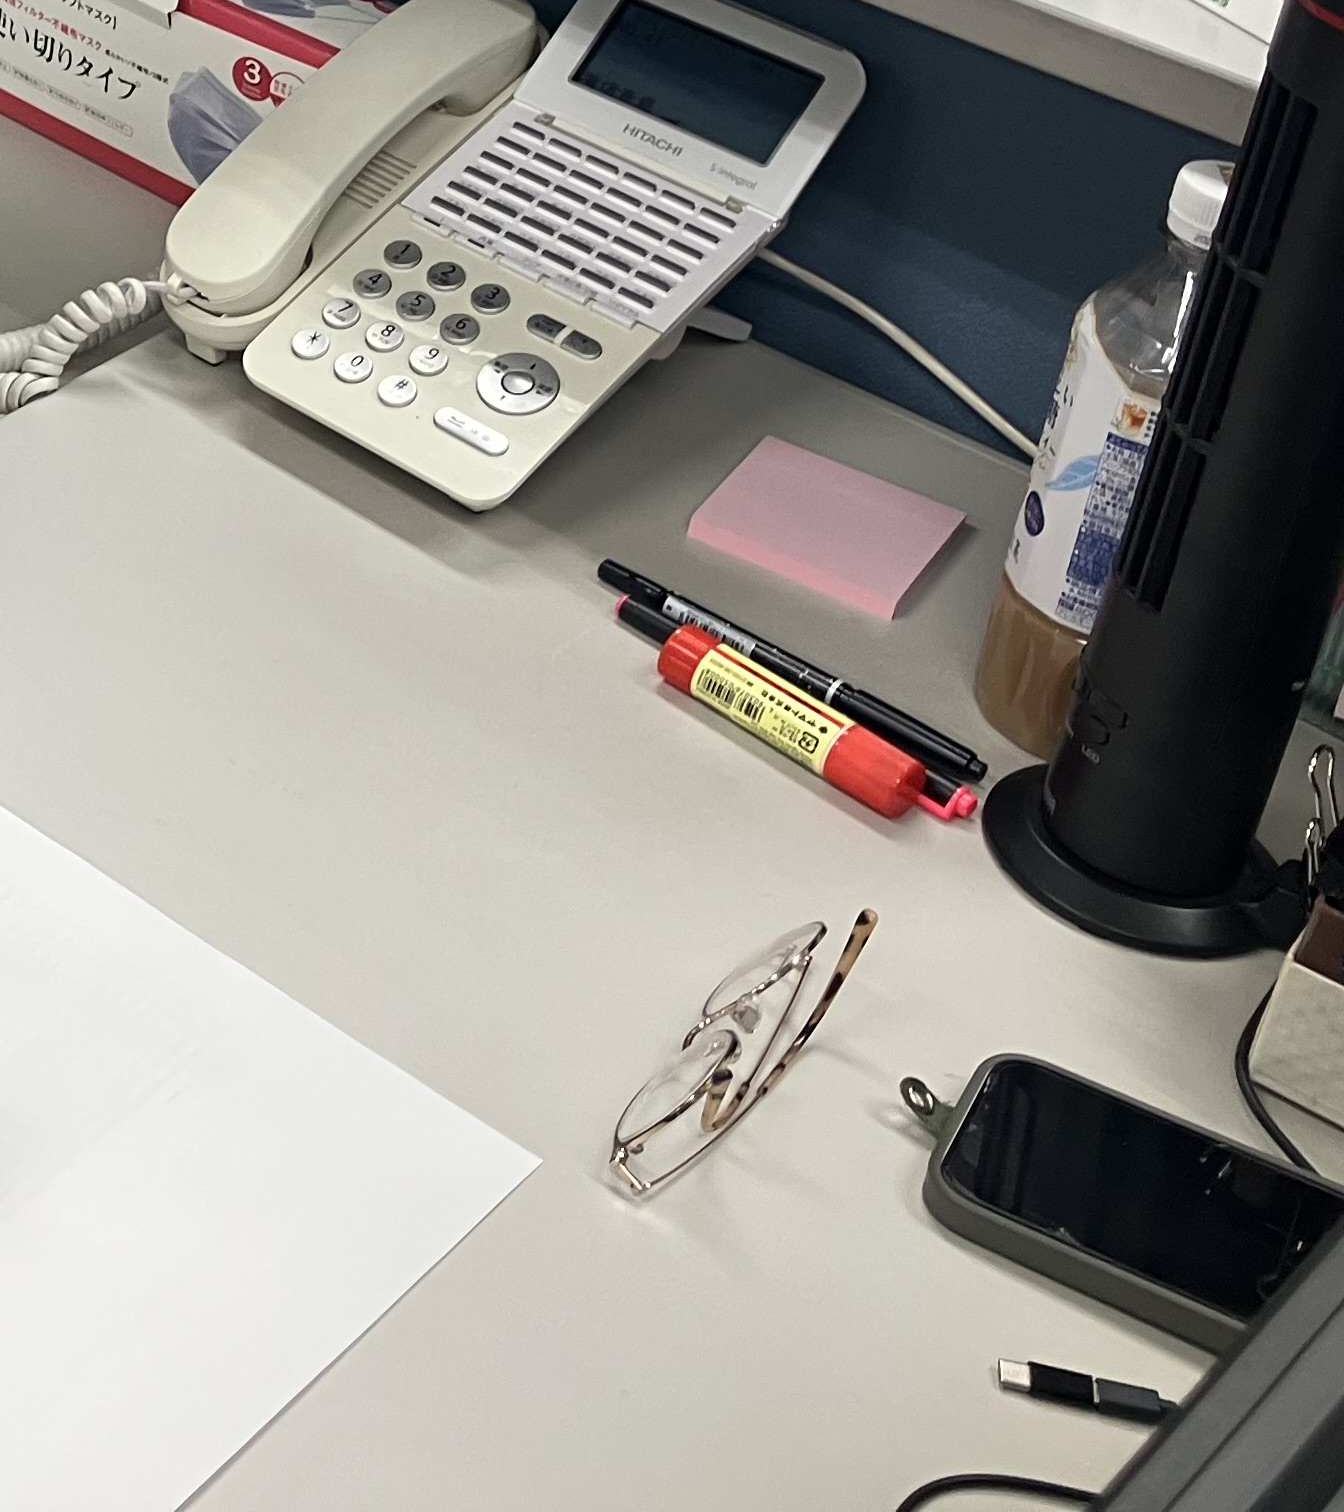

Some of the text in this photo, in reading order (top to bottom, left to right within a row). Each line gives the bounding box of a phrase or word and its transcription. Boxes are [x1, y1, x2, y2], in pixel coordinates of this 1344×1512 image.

[243, 59, 262, 85] 3
[622, 122, 683, 158] HITACHI
[400, 243, 411, 256] 1
[439, 264, 457, 277] 2
[368, 273, 383, 286] 4
[485, 287, 501, 300] 3
[337, 300, 354, 313] 7
[411, 294, 427, 307] 5
[455, 317, 470, 330] 6
[380, 324, 396, 338] 8
[425, 347, 441, 361] 9
[350, 355, 365, 368] 0
[393, 378, 410, 390] #
